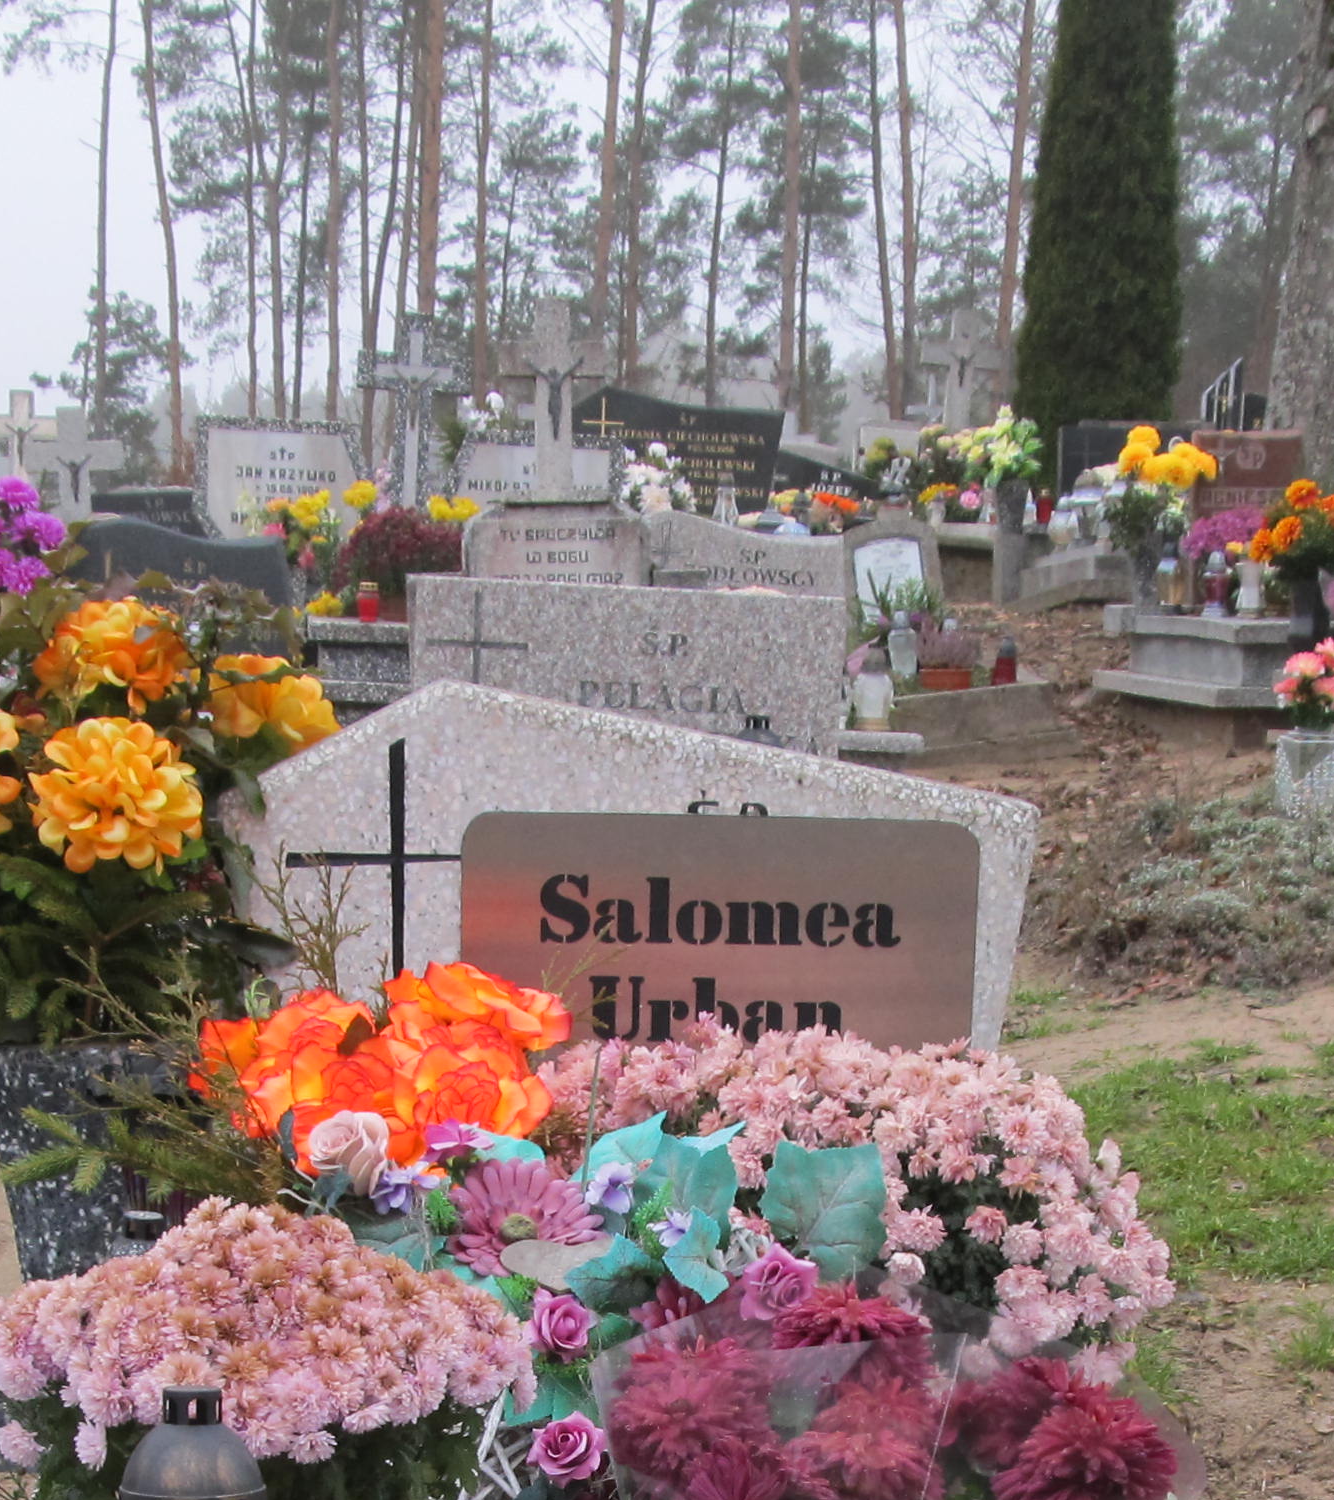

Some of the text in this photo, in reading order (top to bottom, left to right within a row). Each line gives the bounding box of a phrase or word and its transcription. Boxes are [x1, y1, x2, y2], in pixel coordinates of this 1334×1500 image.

[547, 550, 589, 564] BOGU
[577, 680, 748, 715] PELAGIA
[540, 873, 901, 948] Salomea
[589, 976, 843, 1044] Urban
